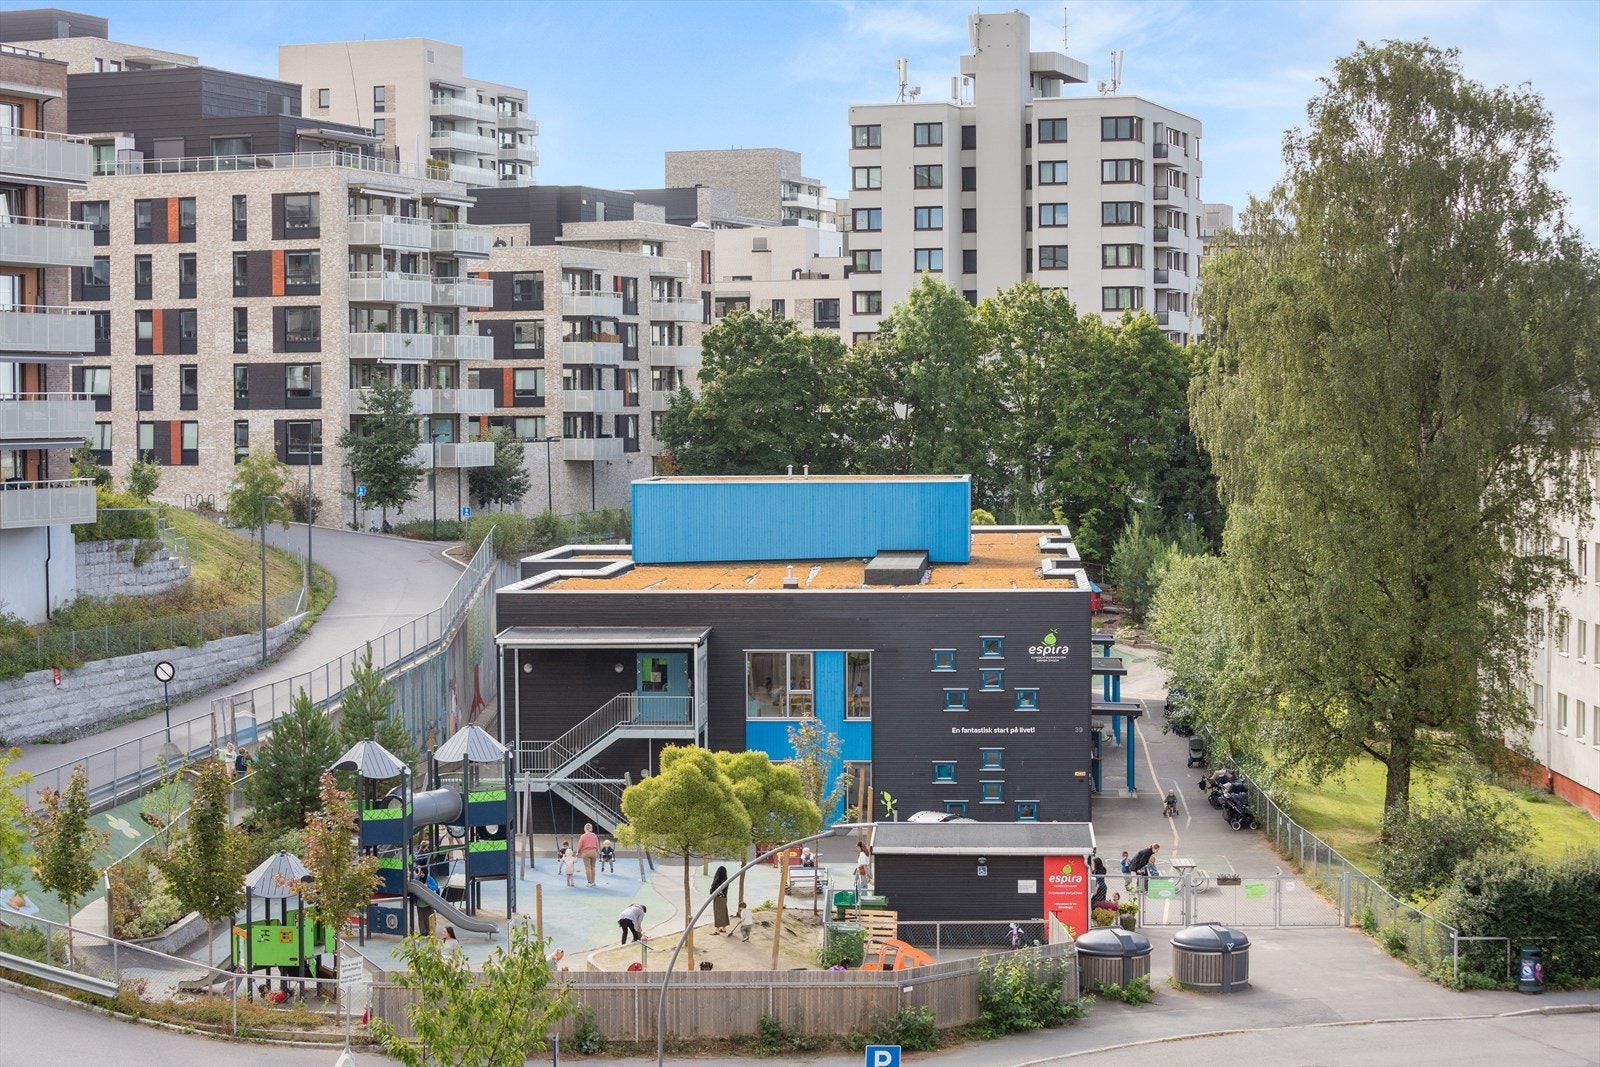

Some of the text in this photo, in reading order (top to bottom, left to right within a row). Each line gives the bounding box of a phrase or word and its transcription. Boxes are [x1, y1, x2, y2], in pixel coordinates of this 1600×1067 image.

[1028, 646, 1069, 656] espira
[961, 726, 993, 734] fantastisk
[1010, 726, 1019, 735] på
[1048, 875, 1082, 884] espira
[874, 1050, 892, 1067] P
